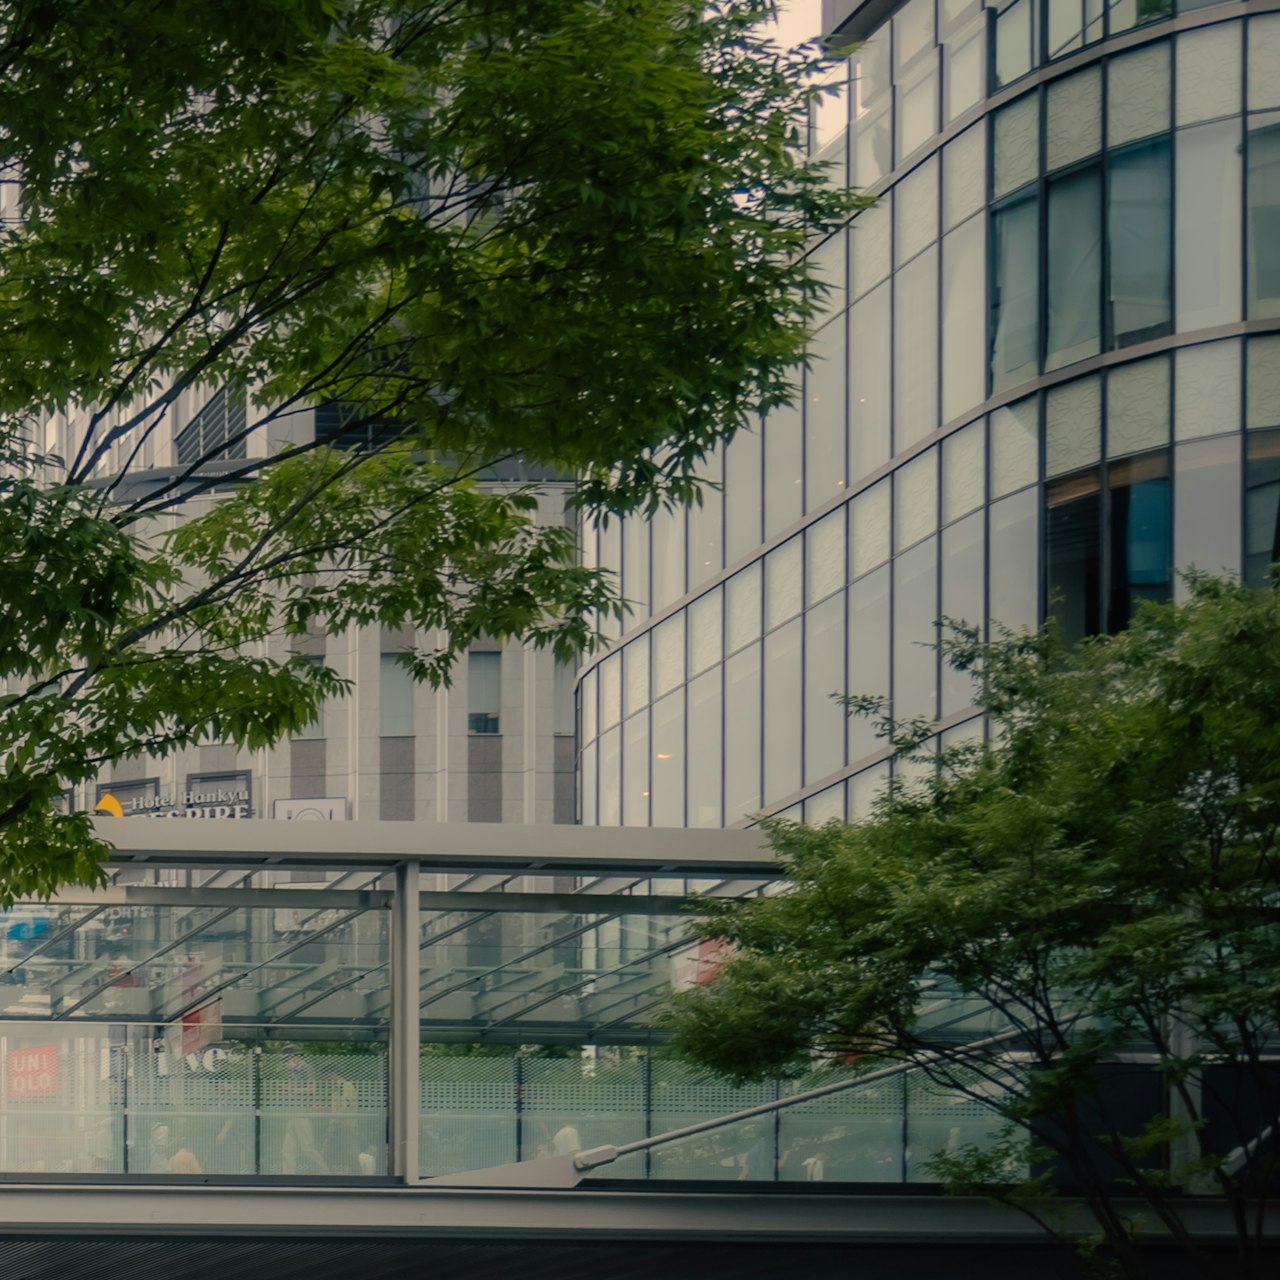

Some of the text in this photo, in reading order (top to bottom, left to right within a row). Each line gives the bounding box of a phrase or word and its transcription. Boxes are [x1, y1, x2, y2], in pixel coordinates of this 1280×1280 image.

[132, 789, 249, 810] Hotel Hankyu
[13, 1053, 48, 1072] UNI
[12, 1072, 52, 1094] QLO
